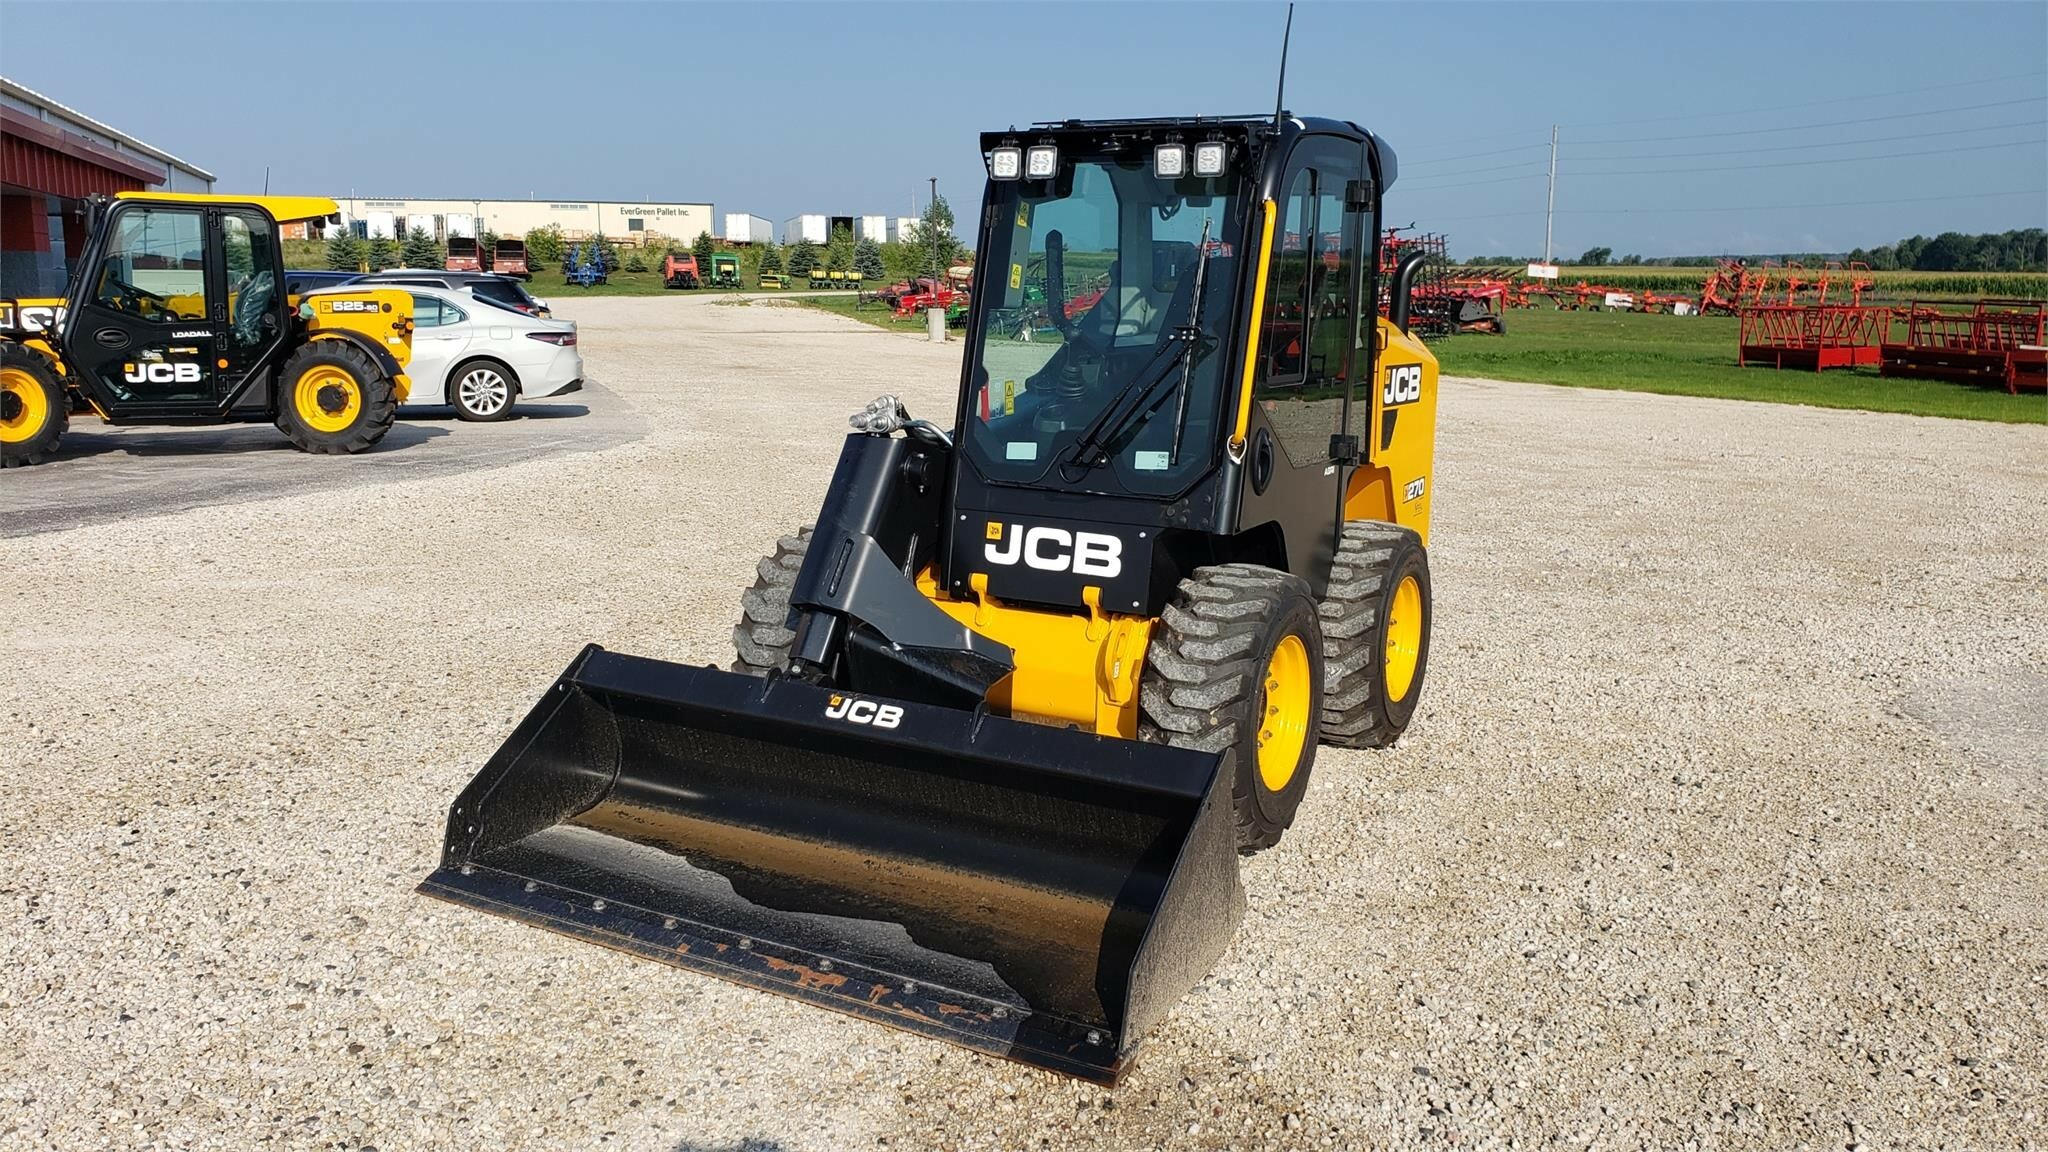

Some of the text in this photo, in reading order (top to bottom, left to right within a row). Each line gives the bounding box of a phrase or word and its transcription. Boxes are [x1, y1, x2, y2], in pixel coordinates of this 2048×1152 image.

[620, 207, 690, 216] EverGreen Pallet Inc.
[124, 363, 201, 383] JCB
[1384, 366, 1421, 404] JCB
[1408, 477, 1425, 500] 270
[985, 523, 1122, 578] JCB
[825, 697, 904, 728] JCB
